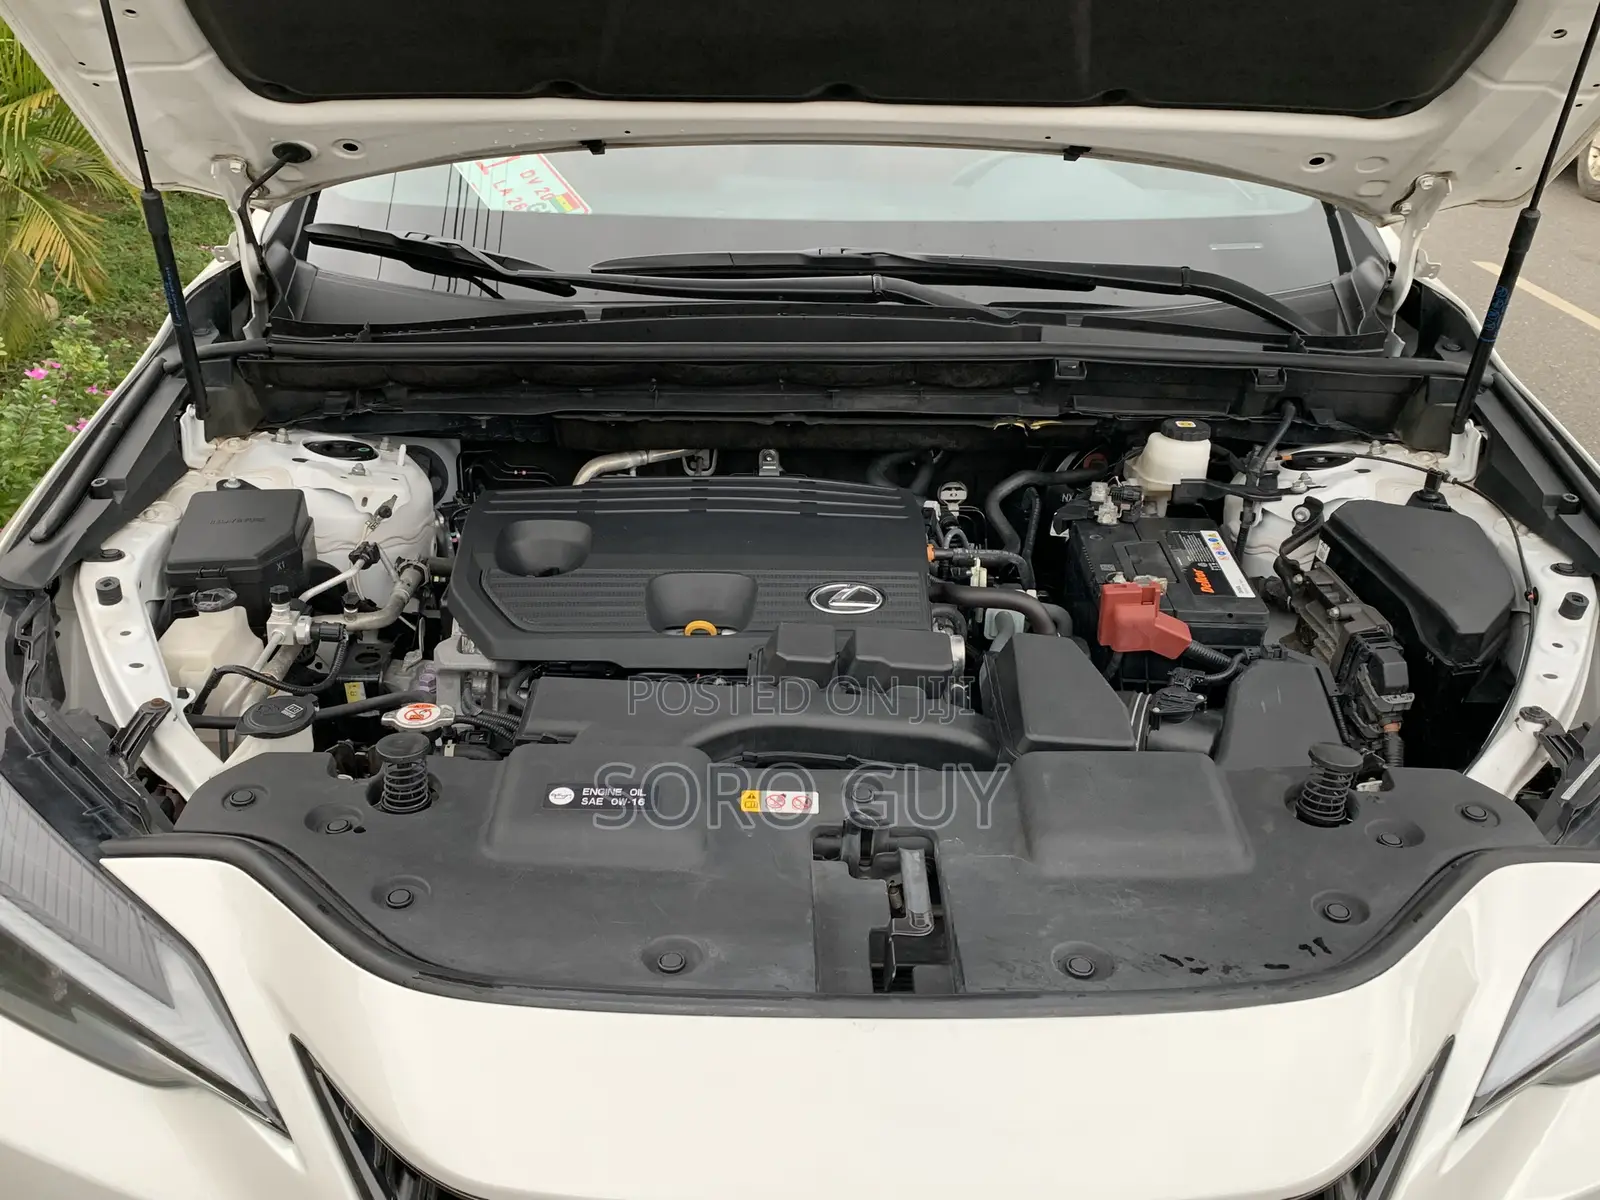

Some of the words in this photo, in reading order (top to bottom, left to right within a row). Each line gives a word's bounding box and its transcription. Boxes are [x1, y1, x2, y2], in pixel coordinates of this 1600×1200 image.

[520, 169, 544, 185] DV
[582, 787, 623, 797] ENGINE
[629, 788, 647, 797] OIL
[581, 797, 604, 806] SAE
[610, 797, 646, 806] 0W-16
